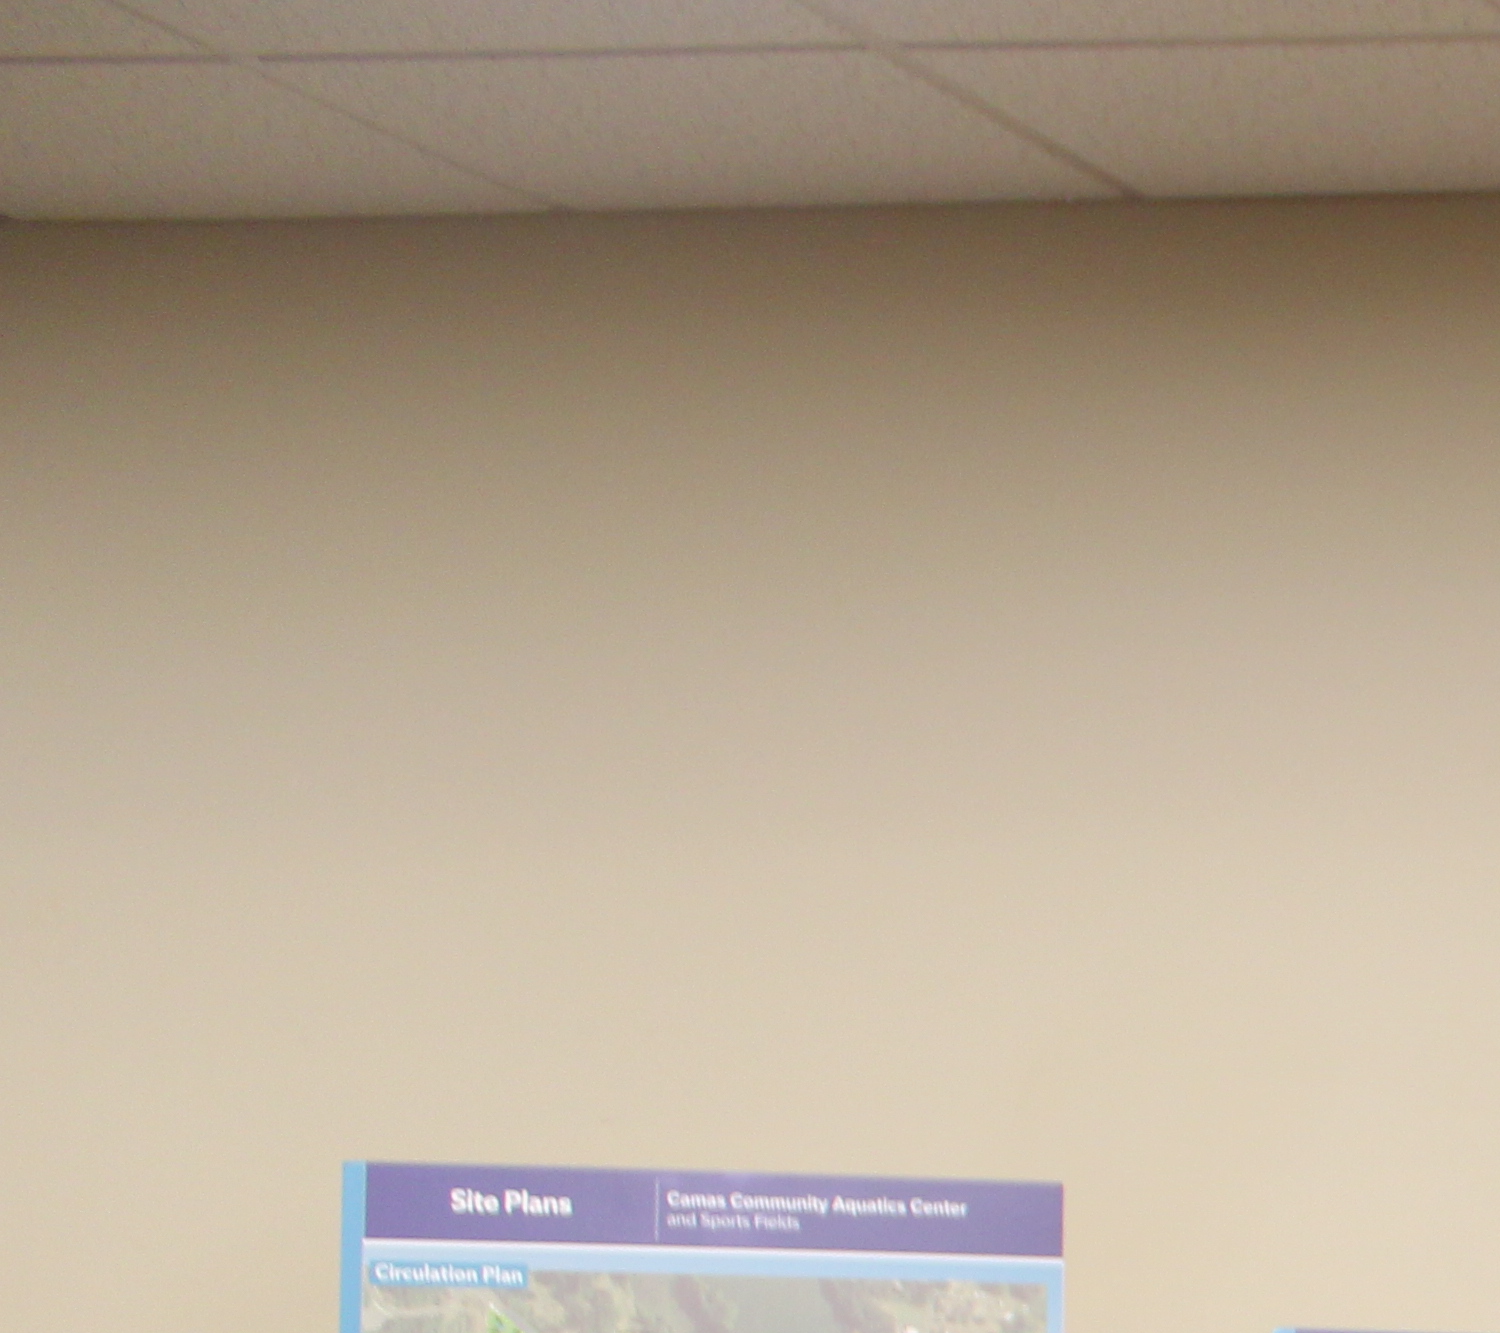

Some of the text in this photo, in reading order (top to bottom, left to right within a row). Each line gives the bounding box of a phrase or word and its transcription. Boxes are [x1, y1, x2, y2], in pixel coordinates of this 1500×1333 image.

[450, 1187, 573, 1218] Site Plans
[667, 1189, 968, 1218] Camas Community Aquatics Center
[667, 1212, 800, 1232] and Sports Fields
[374, 1262, 523, 1285] Circulation Plan
